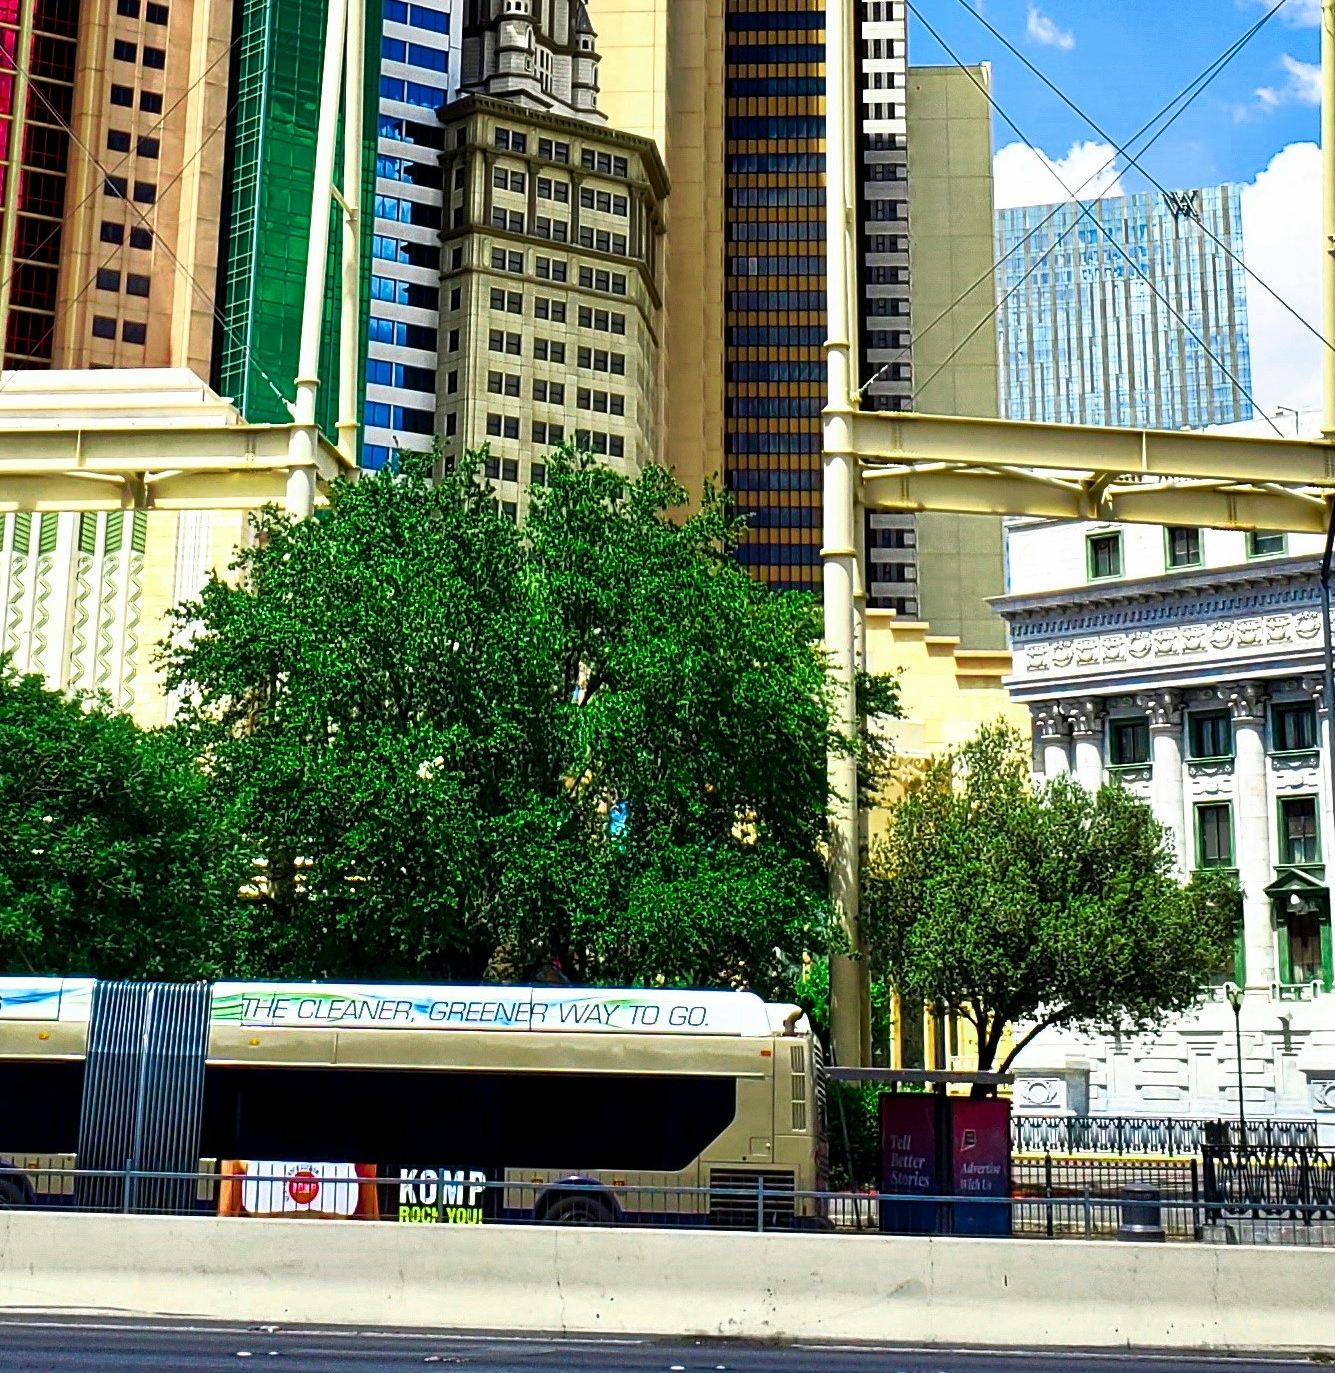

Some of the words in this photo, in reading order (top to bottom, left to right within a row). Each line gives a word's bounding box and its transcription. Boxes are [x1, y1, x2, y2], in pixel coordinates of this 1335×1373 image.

[242, 997, 291, 1019] THE
[297, 999, 415, 1023] CLEANER,
[428, 1001, 549, 1023] GREENER
[559, 1003, 621, 1025] WAY
[628, 1005, 660, 1026] TO
[668, 1006, 710, 1027] GO.
[890, 1135, 911, 1150] Tell
[891, 1153, 925, 1169] Better
[962, 1162, 1001, 1175] Advertise
[891, 1170, 930, 1187] Stories
[399, 1168, 487, 1206] KOMP
